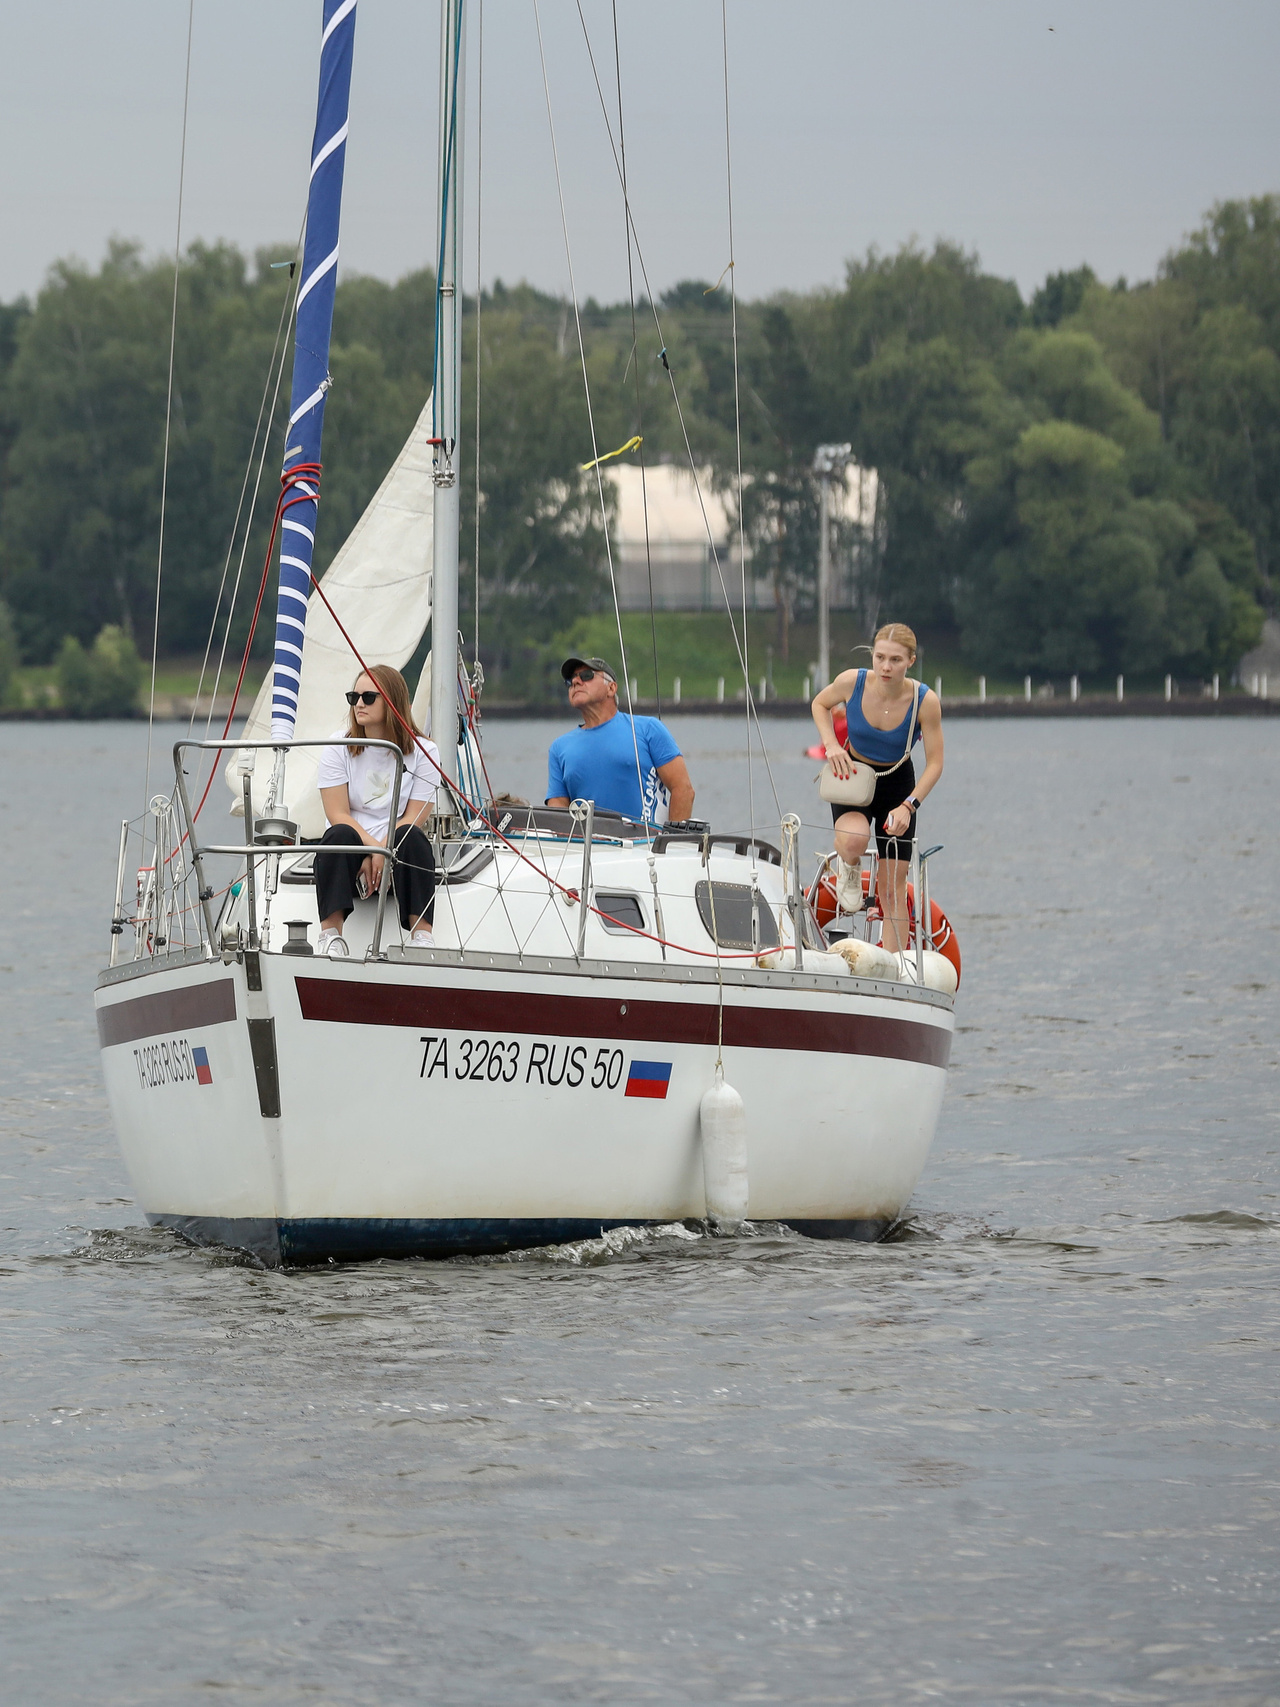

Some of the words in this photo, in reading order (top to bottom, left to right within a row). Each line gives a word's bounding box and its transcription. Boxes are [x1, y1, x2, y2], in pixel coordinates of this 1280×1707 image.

[133, 1049, 149, 1089] TA
[143, 1044, 166, 1088] 3263
[161, 1040, 184, 1083] RUS
[180, 1039, 195, 1080] 50
[420, 1037, 448, 1079] TA
[455, 1038, 520, 1083] 3263
[525, 1042, 587, 1088] RUS
[591, 1048, 624, 1090] 50
